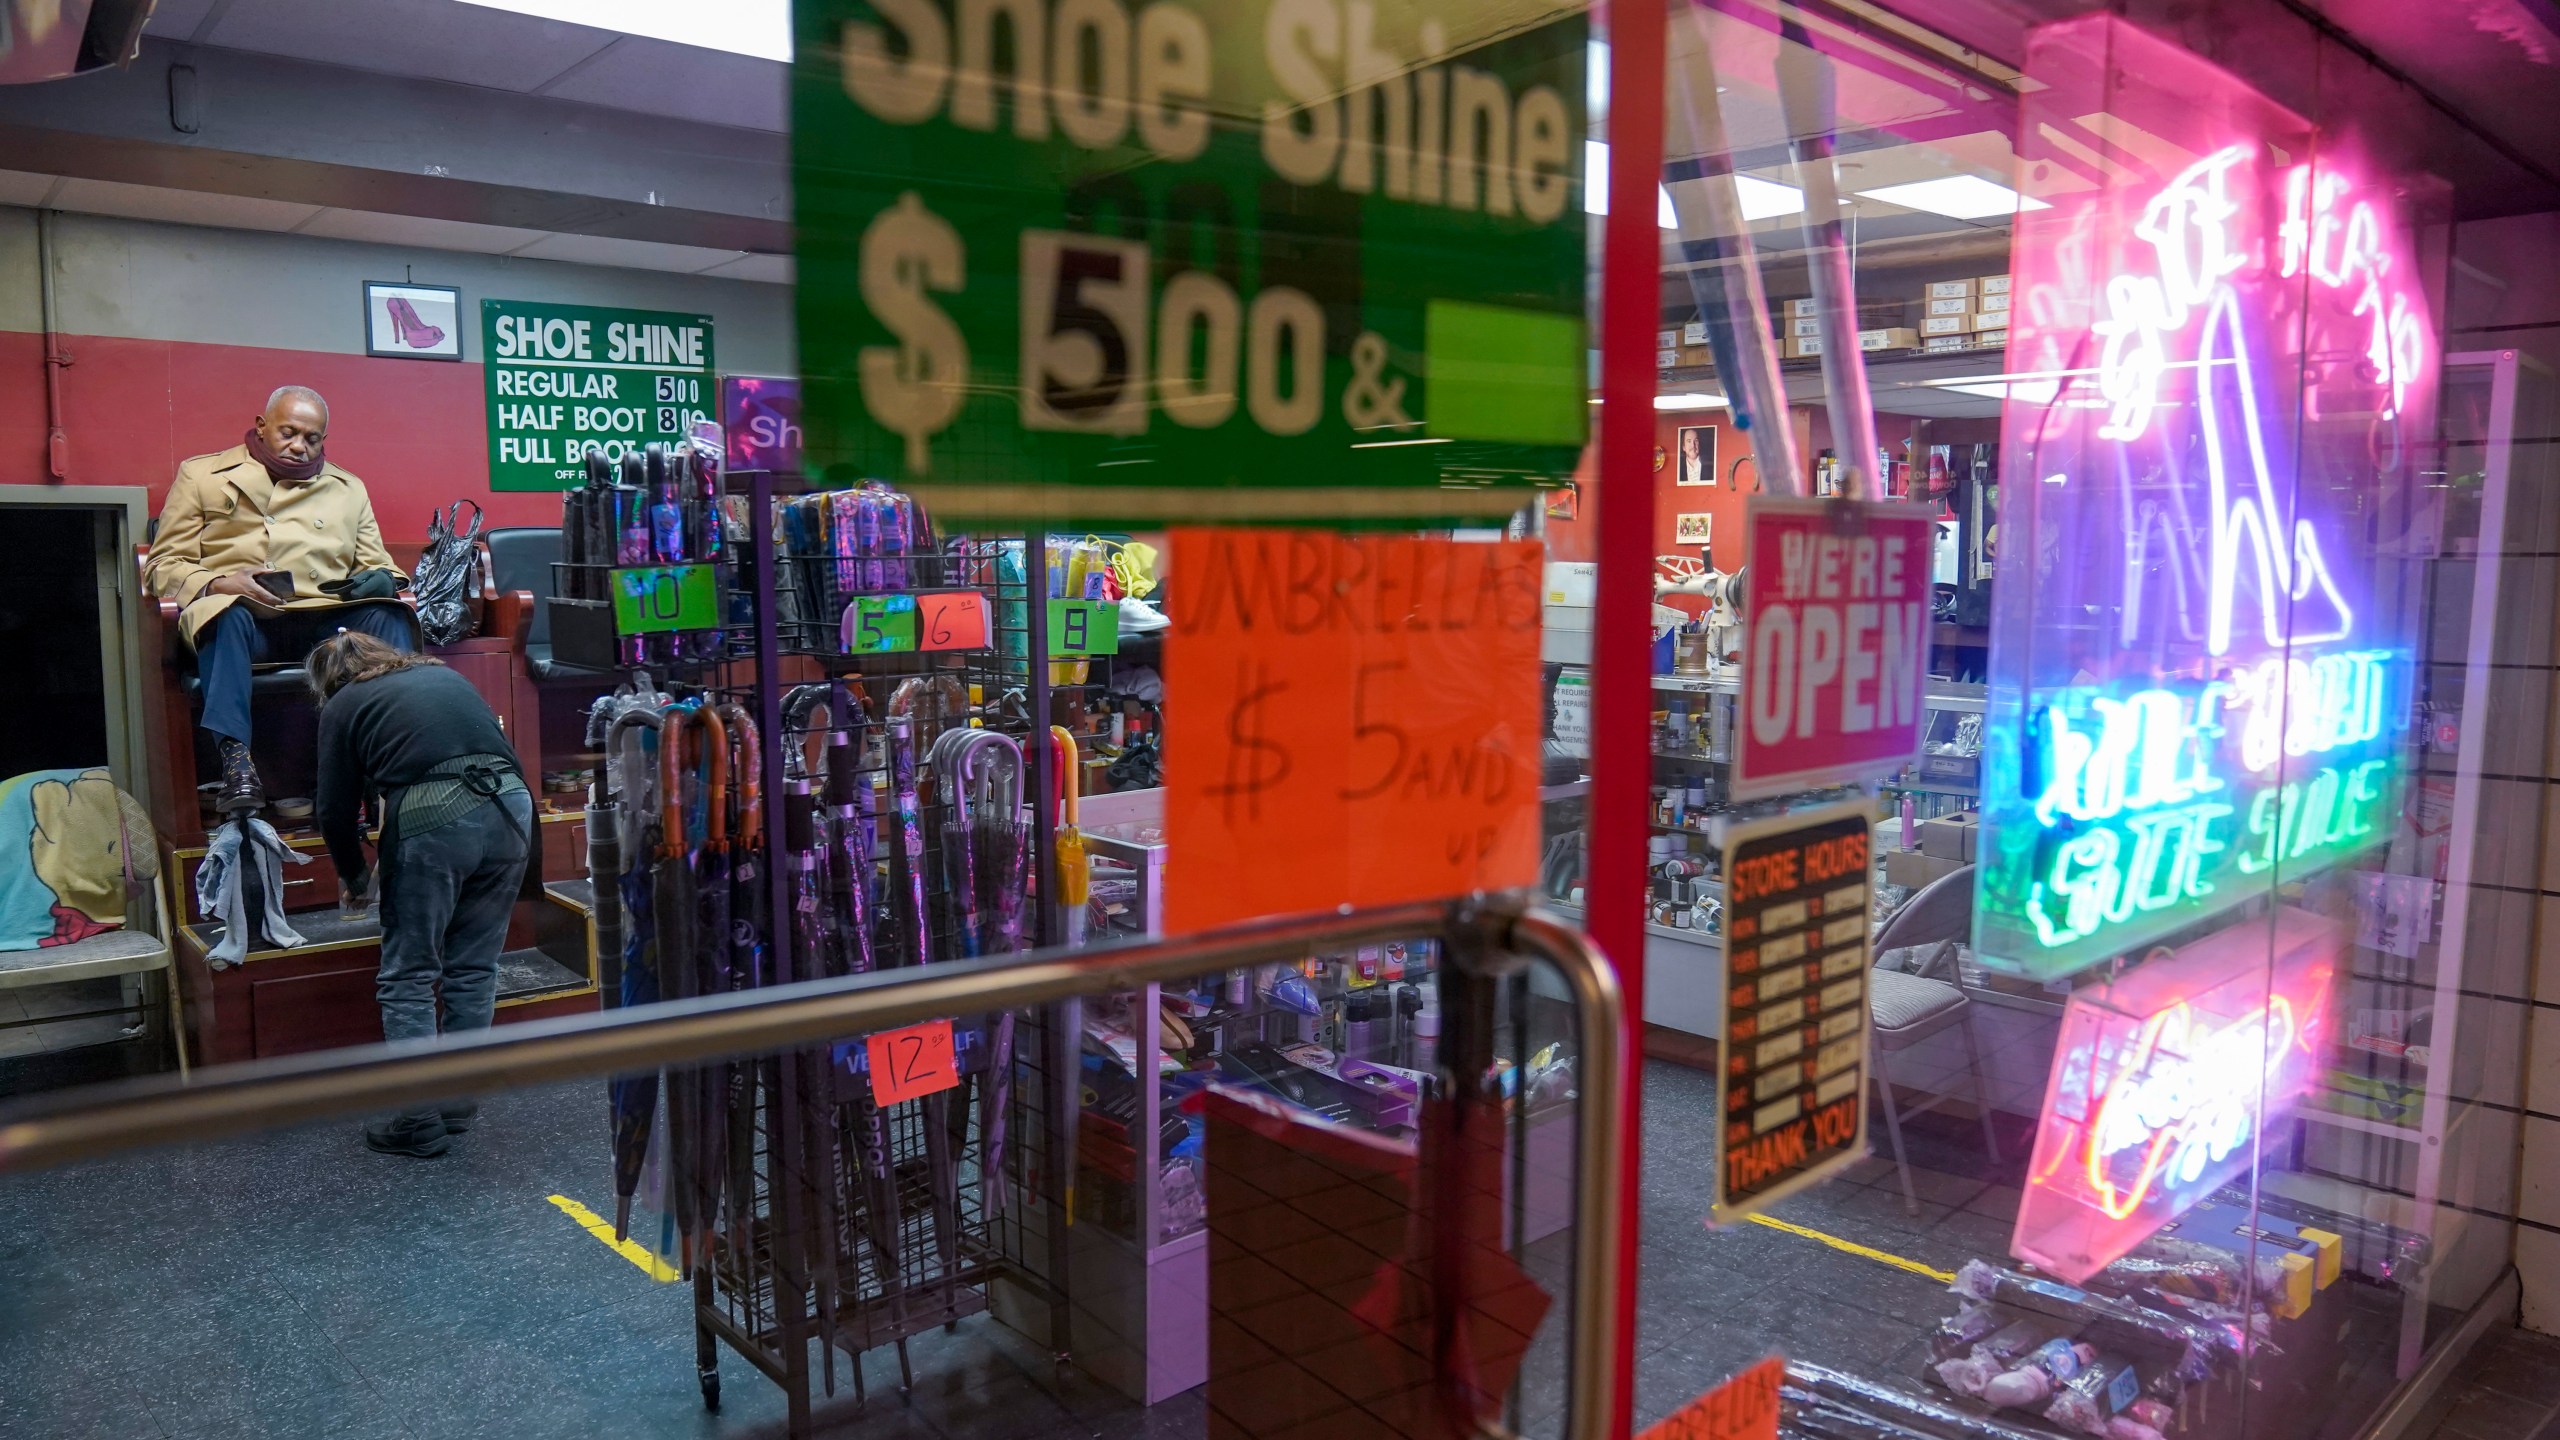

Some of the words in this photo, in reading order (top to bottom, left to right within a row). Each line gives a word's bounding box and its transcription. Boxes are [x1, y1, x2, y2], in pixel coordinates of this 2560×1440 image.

[842, 0, 1210, 163] Shoe
[1262, 0, 1570, 226] Shine
[496, 315, 591, 359] SHOE
[607, 321, 704, 364] SHINE
[497, 370, 618, 399] REGULAR
[1343, 330, 1414, 432] &
[498, 404, 563, 431] HALF
[574, 406, 646, 433] BOOT
[749, 415, 803, 450] Sh
[500, 437, 555, 464] FULL
[565, 439, 636, 464] BOOT
[555, 470, 575, 480] OFF
[1782, 530, 1906, 600] WE'RE
[638, 572, 679, 620] 10
[931, 605, 951, 645] 6
[1064, 608, 1087, 650] 8
[1752, 602, 1921, 747] OPEN
[1563, 700, 1588, 708] REPAIRS
[1202, 655, 1293, 828] $
[1336, 658, 1408, 802] 5
[1402, 738, 1516, 806] AND
[1732, 850, 1800, 902] STORE
[1804, 831, 1868, 885] HOURS
[887, 1035, 938, 1093] 12
[1727, 1118, 1807, 1197] THANK
[1811, 1098, 1857, 1154] YOU
